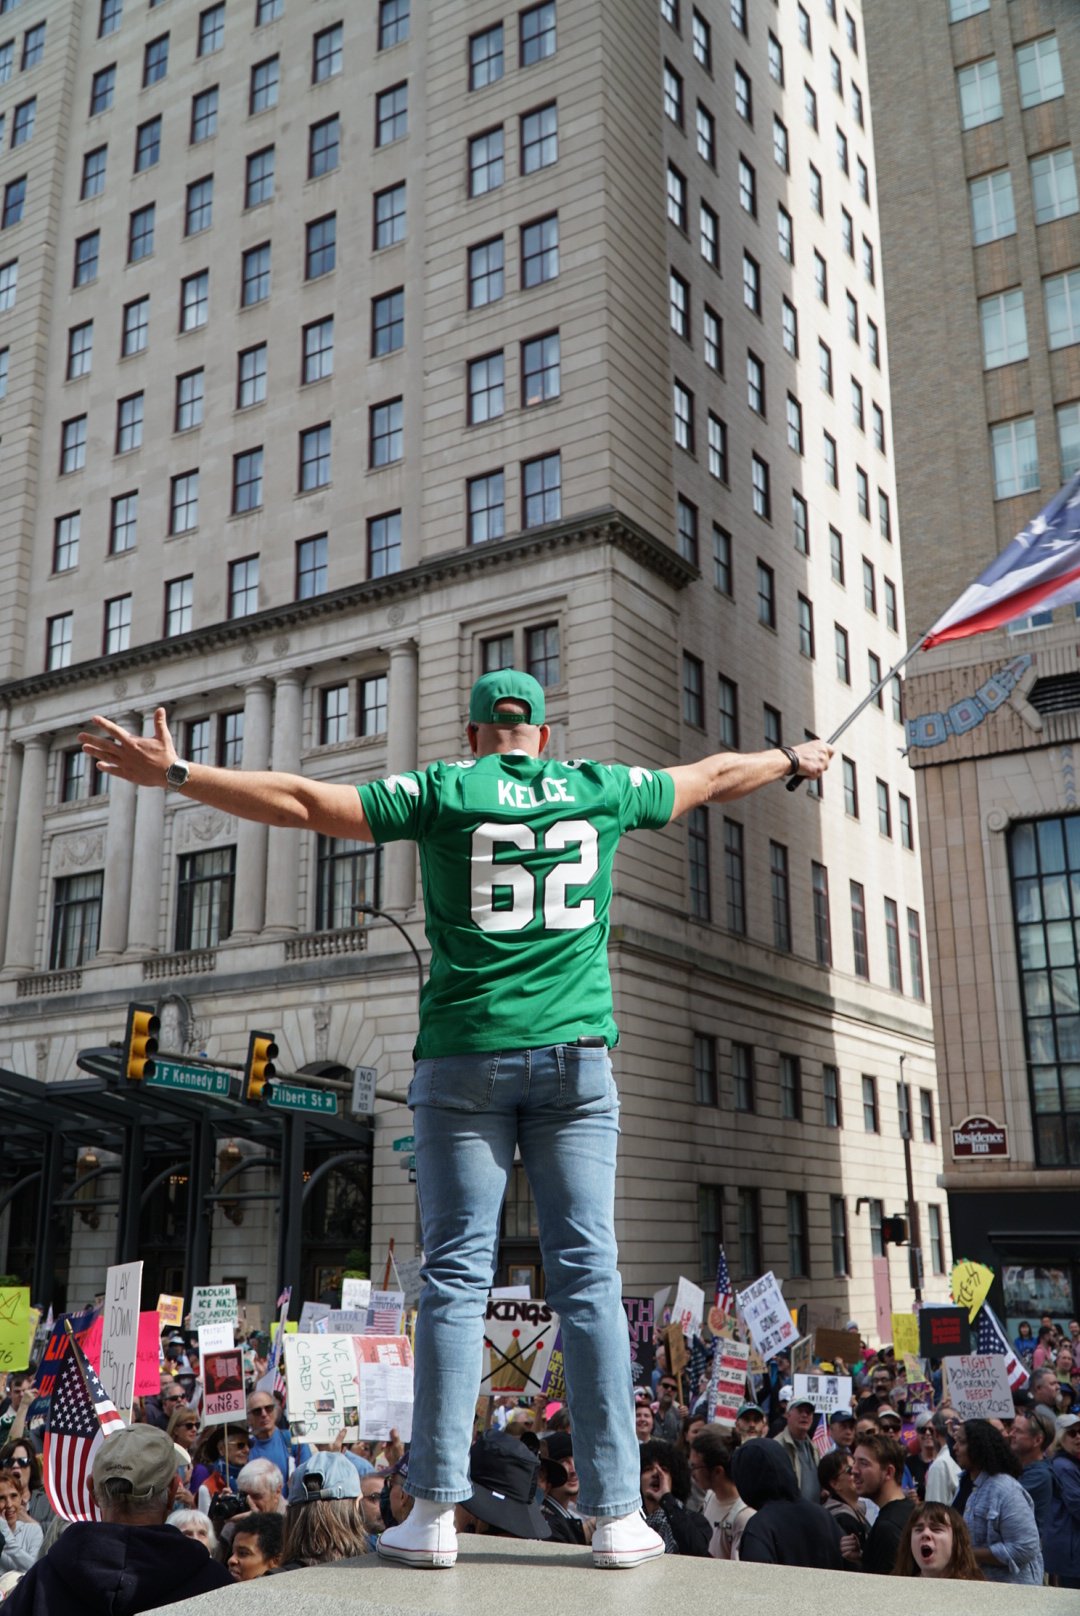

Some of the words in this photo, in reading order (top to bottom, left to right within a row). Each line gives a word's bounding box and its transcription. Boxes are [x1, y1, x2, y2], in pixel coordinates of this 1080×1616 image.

[497, 777, 576, 808] KELCE
[470, 819, 600, 931] 62
[153, 1065, 159, 1080] J
[162, 1067, 170, 1081] F
[173, 1068, 213, 1091] Kennedy
[360, 1072, 373, 1082] NO
[272, 1087, 306, 1106] Filbert
[311, 1093, 322, 1108] St
[954, 1131, 1004, 1144] Residence
[971, 1142, 990, 1154] Inn
[114, 1271, 131, 1301] LAY
[197, 1287, 231, 1297] ABOLISH
[199, 1299, 211, 1308] ICE
[486, 1301, 554, 1327] KINGS
[110, 1305, 133, 1338] DOWN
[331, 1339, 349, 1362] WE
[296, 1341, 312, 1392] CARED
[960, 1356, 993, 1369] FIGHT
[949, 1367, 1000, 1382] DOMESTIC
[217, 1393, 233, 1401] NO
[316, 1352, 338, 1402] MUST
[327, 1413, 341, 1437] BE
[338, 1372, 357, 1404] ALL
[965, 1388, 993, 1401] DEFEAT
[206, 1399, 240, 1415] KINGS
[303, 1401, 319, 1434] FOR
